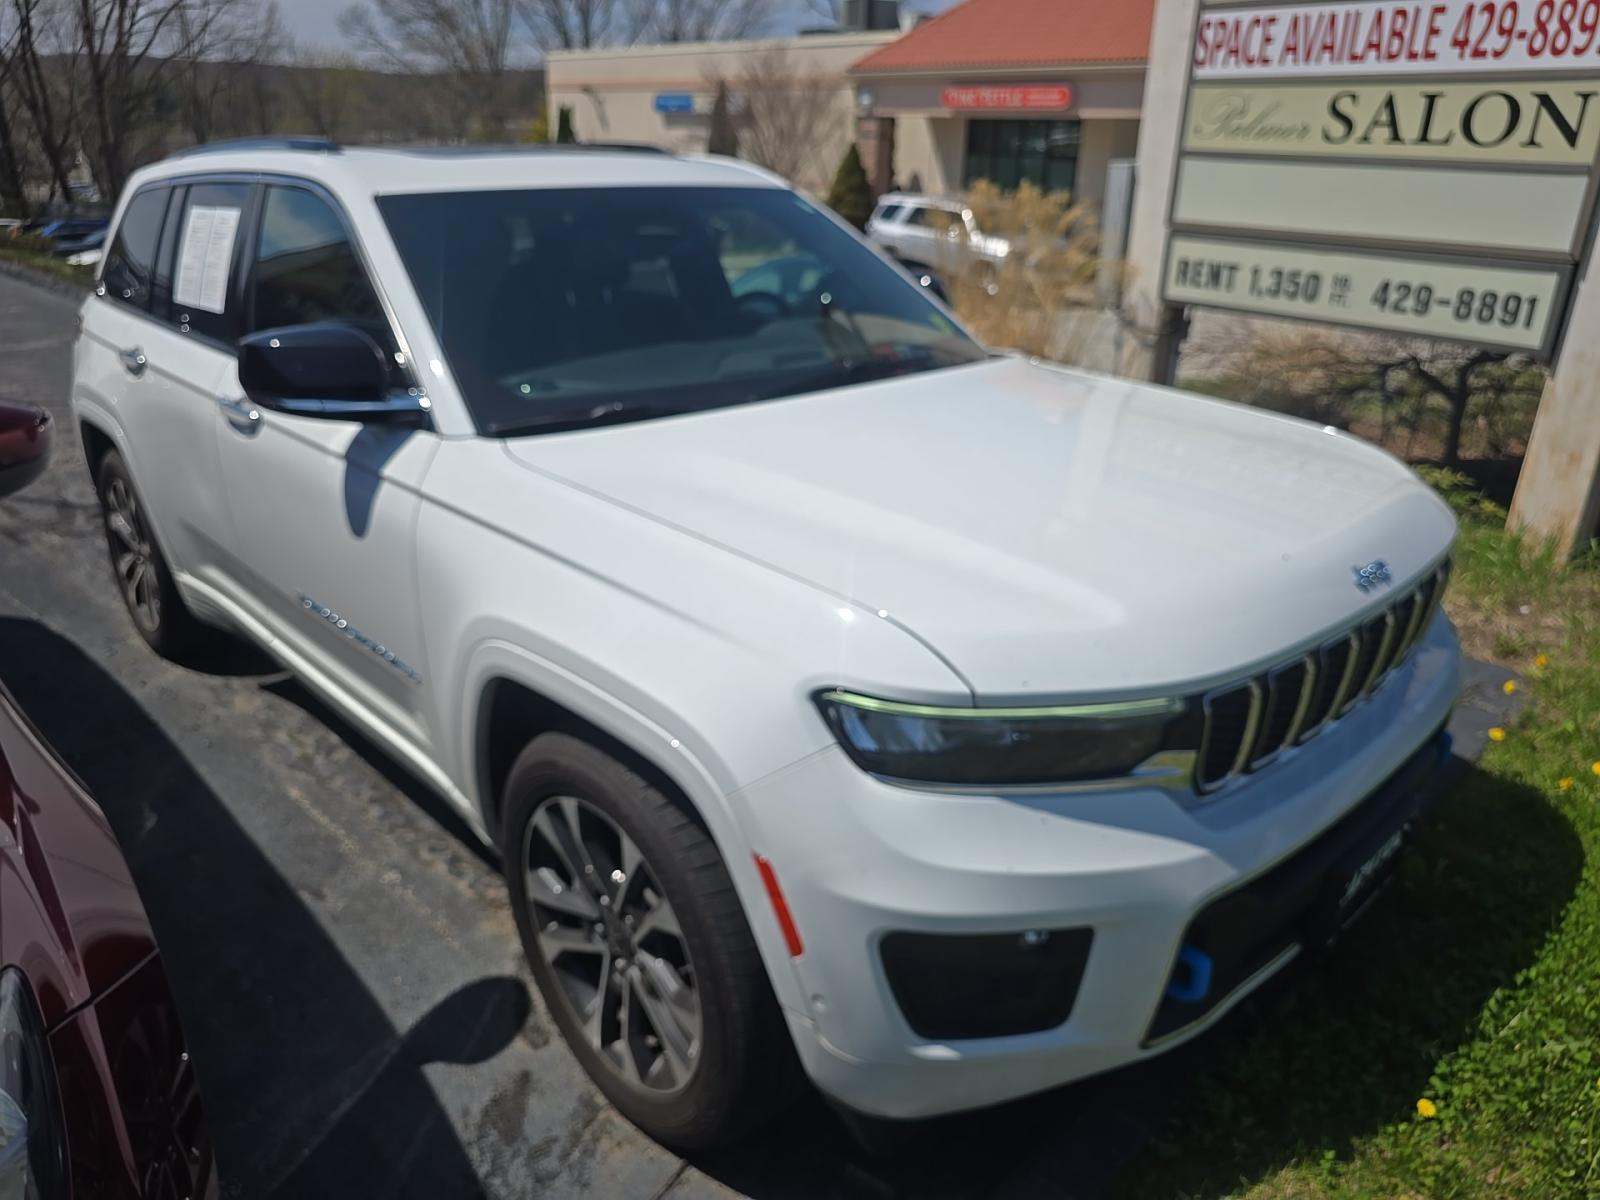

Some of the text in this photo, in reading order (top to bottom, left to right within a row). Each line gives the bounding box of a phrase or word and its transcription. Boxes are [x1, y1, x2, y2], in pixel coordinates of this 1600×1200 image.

[1194, 0, 1600, 68] SPACE AVAILABLE 429-889
[1321, 89, 1599, 150] SALON
[1175, 257, 1240, 292] RENT
[1370, 278, 1539, 330] 429-8891
